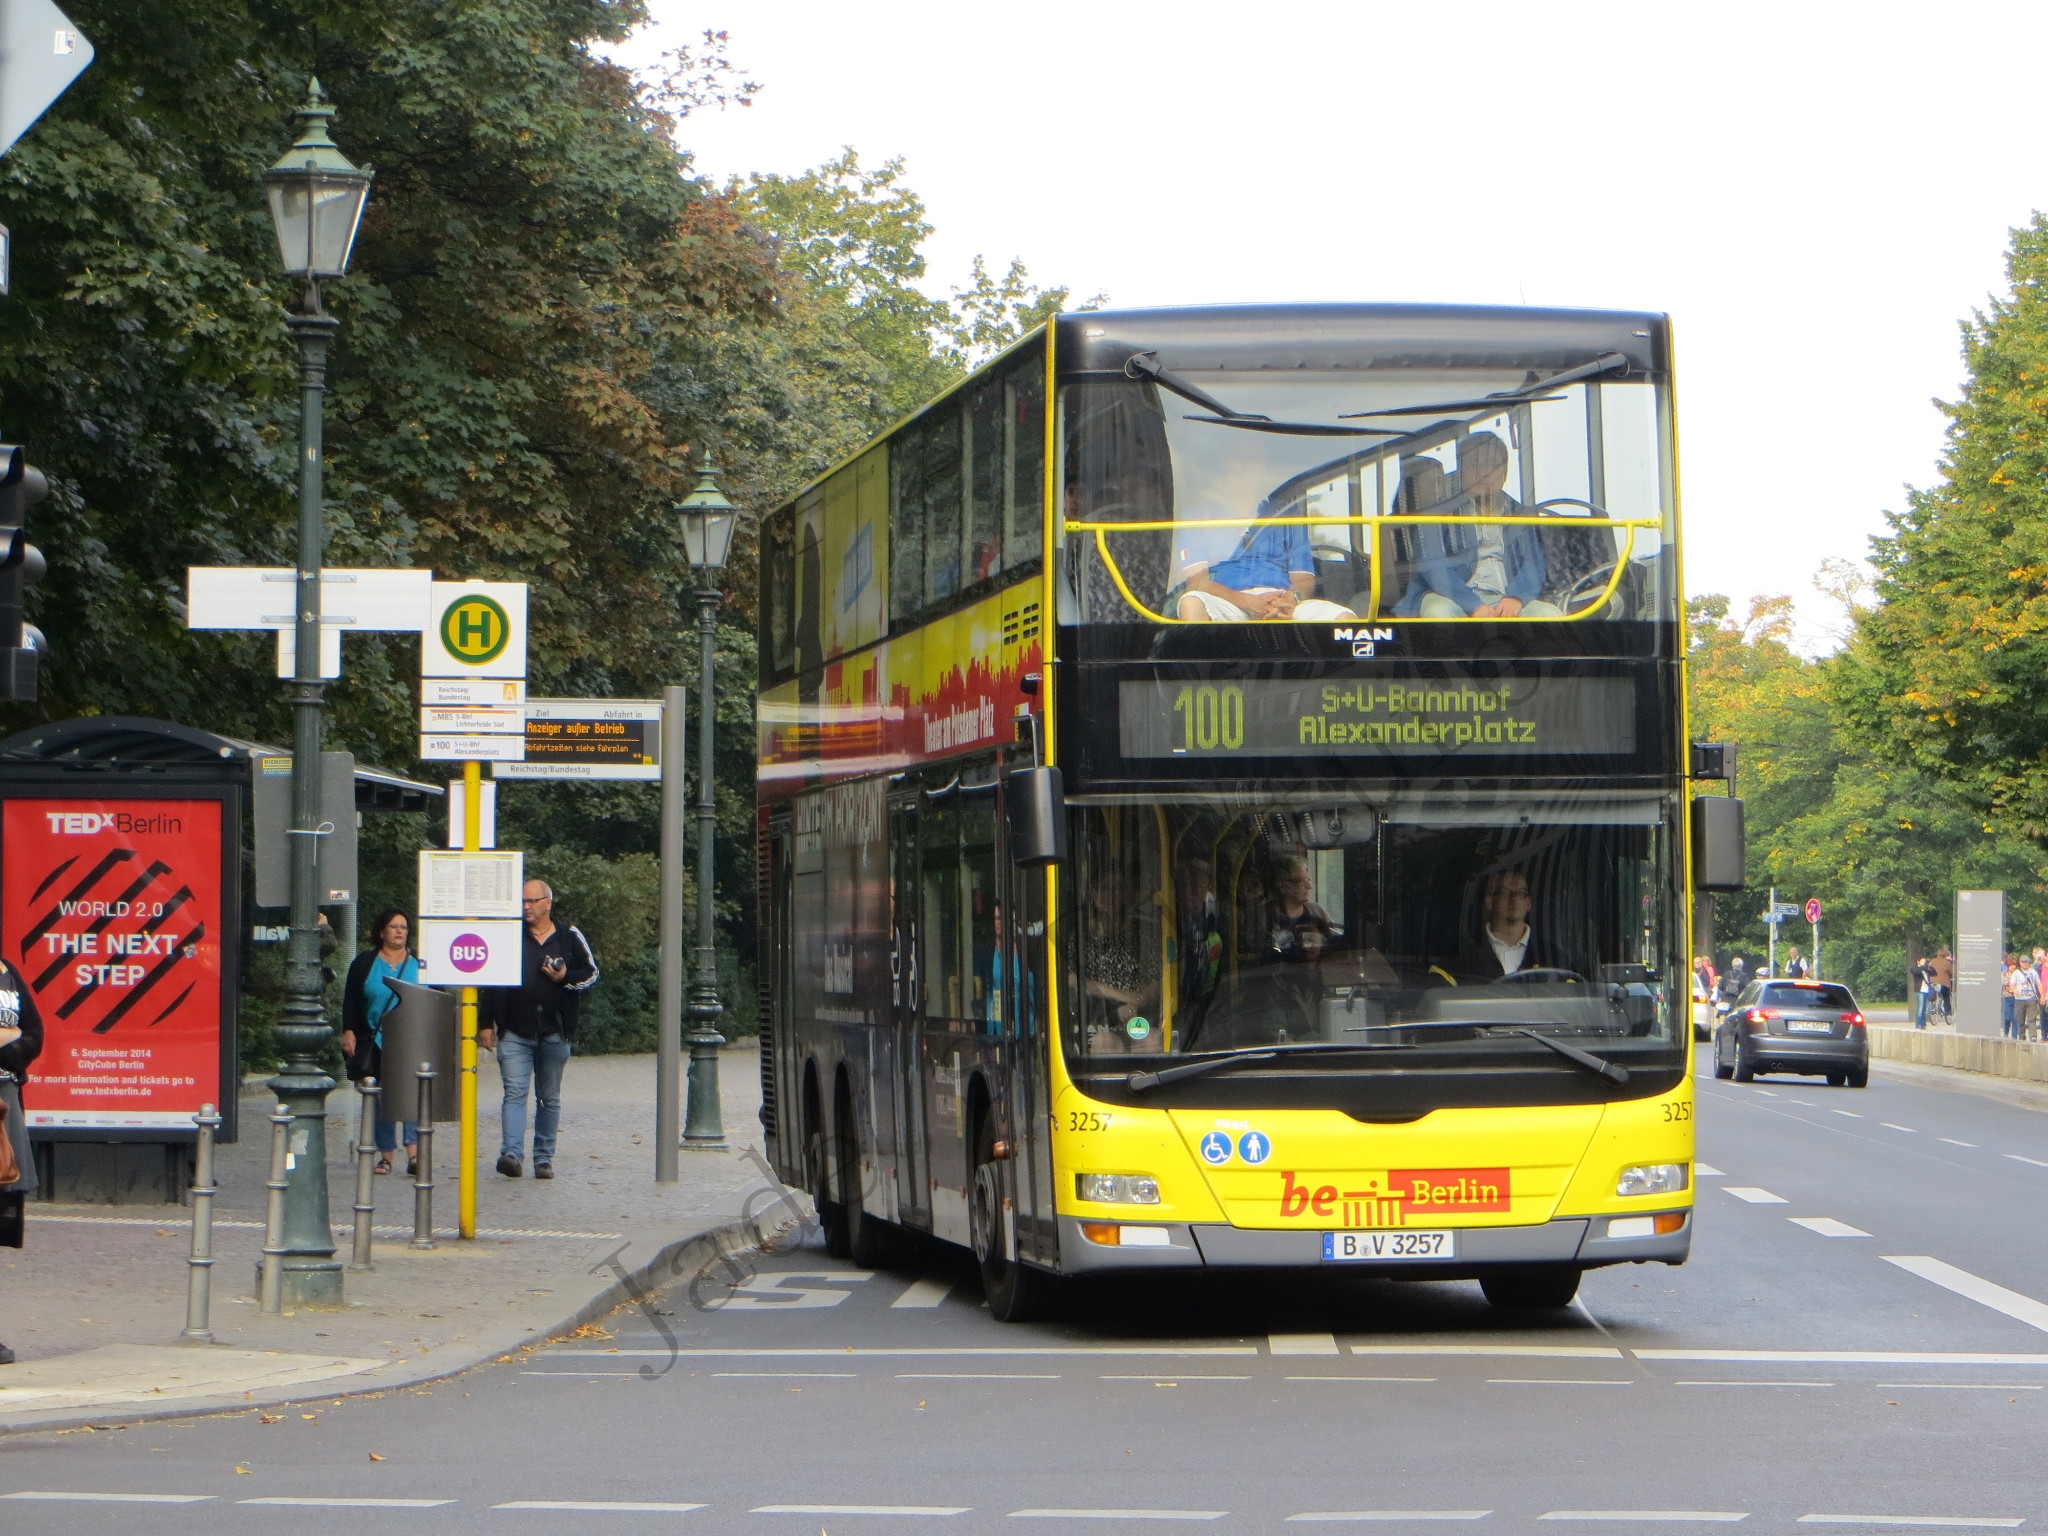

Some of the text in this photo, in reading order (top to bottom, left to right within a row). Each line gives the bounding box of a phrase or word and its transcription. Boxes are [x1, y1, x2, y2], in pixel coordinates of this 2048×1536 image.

[459, 611, 490, 647] H
[1334, 628, 1393, 641] MAN
[535, 709, 550, 717] Ziel
[603, 710, 633, 718] Abfahrt
[635, 710, 643, 718] in
[1174, 684, 1511, 750] 100 S+U-Bahnhof
[527, 722, 625, 736] Anzeiger außer Betrieb
[1300, 716, 1536, 746] Alexanderplatz
[436, 741, 451, 750] 100
[454, 748, 499, 756] Alexanderplatz
[576, 744, 596, 752] siehe
[598, 744, 629, 753] Fahrplan
[511, 765, 591, 774] Reichstag/Bundestag
[59, 900, 164, 917] WORLD 2.0
[43, 933, 178, 955] THE NEXT
[452, 946, 486, 961] BUS
[76, 965, 145, 986] STEP
[71, 1049, 151, 1060] 6. September 2014
[78, 1060, 145, 1070] CityCube Berlin
[28, 1075, 194, 1087] For more information and tickets go to
[71, 1087, 152, 1096] www.tedxberlin.de
[1661, 1101, 1693, 1122] 3257
[1070, 1112, 1113, 1132] 3257
[1280, 1171, 1499, 1217] be Berlin
[1343, 1235, 1357, 1256] B
[1372, 1234, 1386, 1255] V
[1392, 1233, 1445, 1255] 3257
